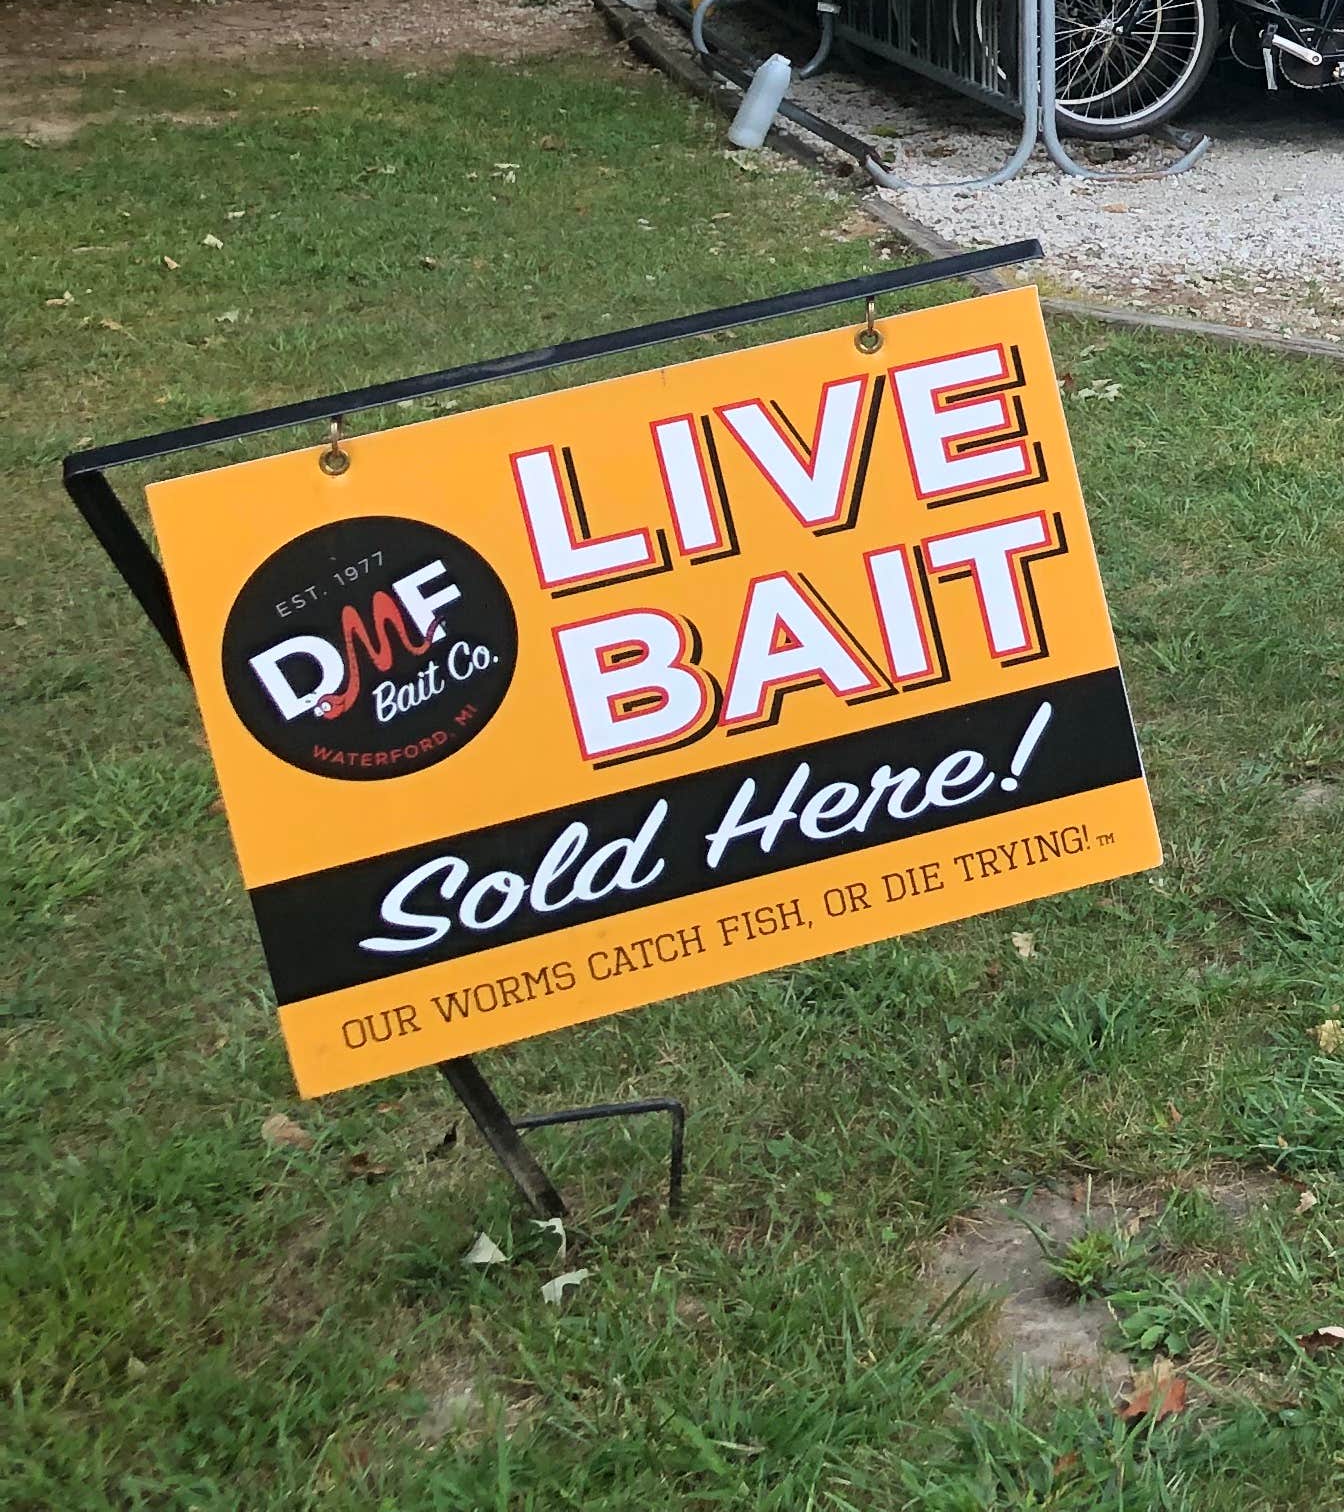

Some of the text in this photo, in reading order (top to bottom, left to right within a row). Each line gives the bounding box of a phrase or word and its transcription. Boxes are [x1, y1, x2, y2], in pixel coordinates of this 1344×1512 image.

[275, 550, 384, 618] EST. 1977
[510, 342, 1048, 600] LIVE
[372, 640, 500, 723] Bait Co.
[454, 703, 478, 727] MI
[551, 509, 1069, 771] BAIT
[341, 1004, 421, 1050] OUR
[431, 962, 576, 1024] WORMS
[586, 925, 706, 982] CATCH
[717, 899, 814, 947] FISH,
[823, 883, 872, 918] OR
[881, 862, 945, 903] DIE
[953, 824, 1091, 883] TRYING!
[358, 701, 1053, 952] Sold Here!
